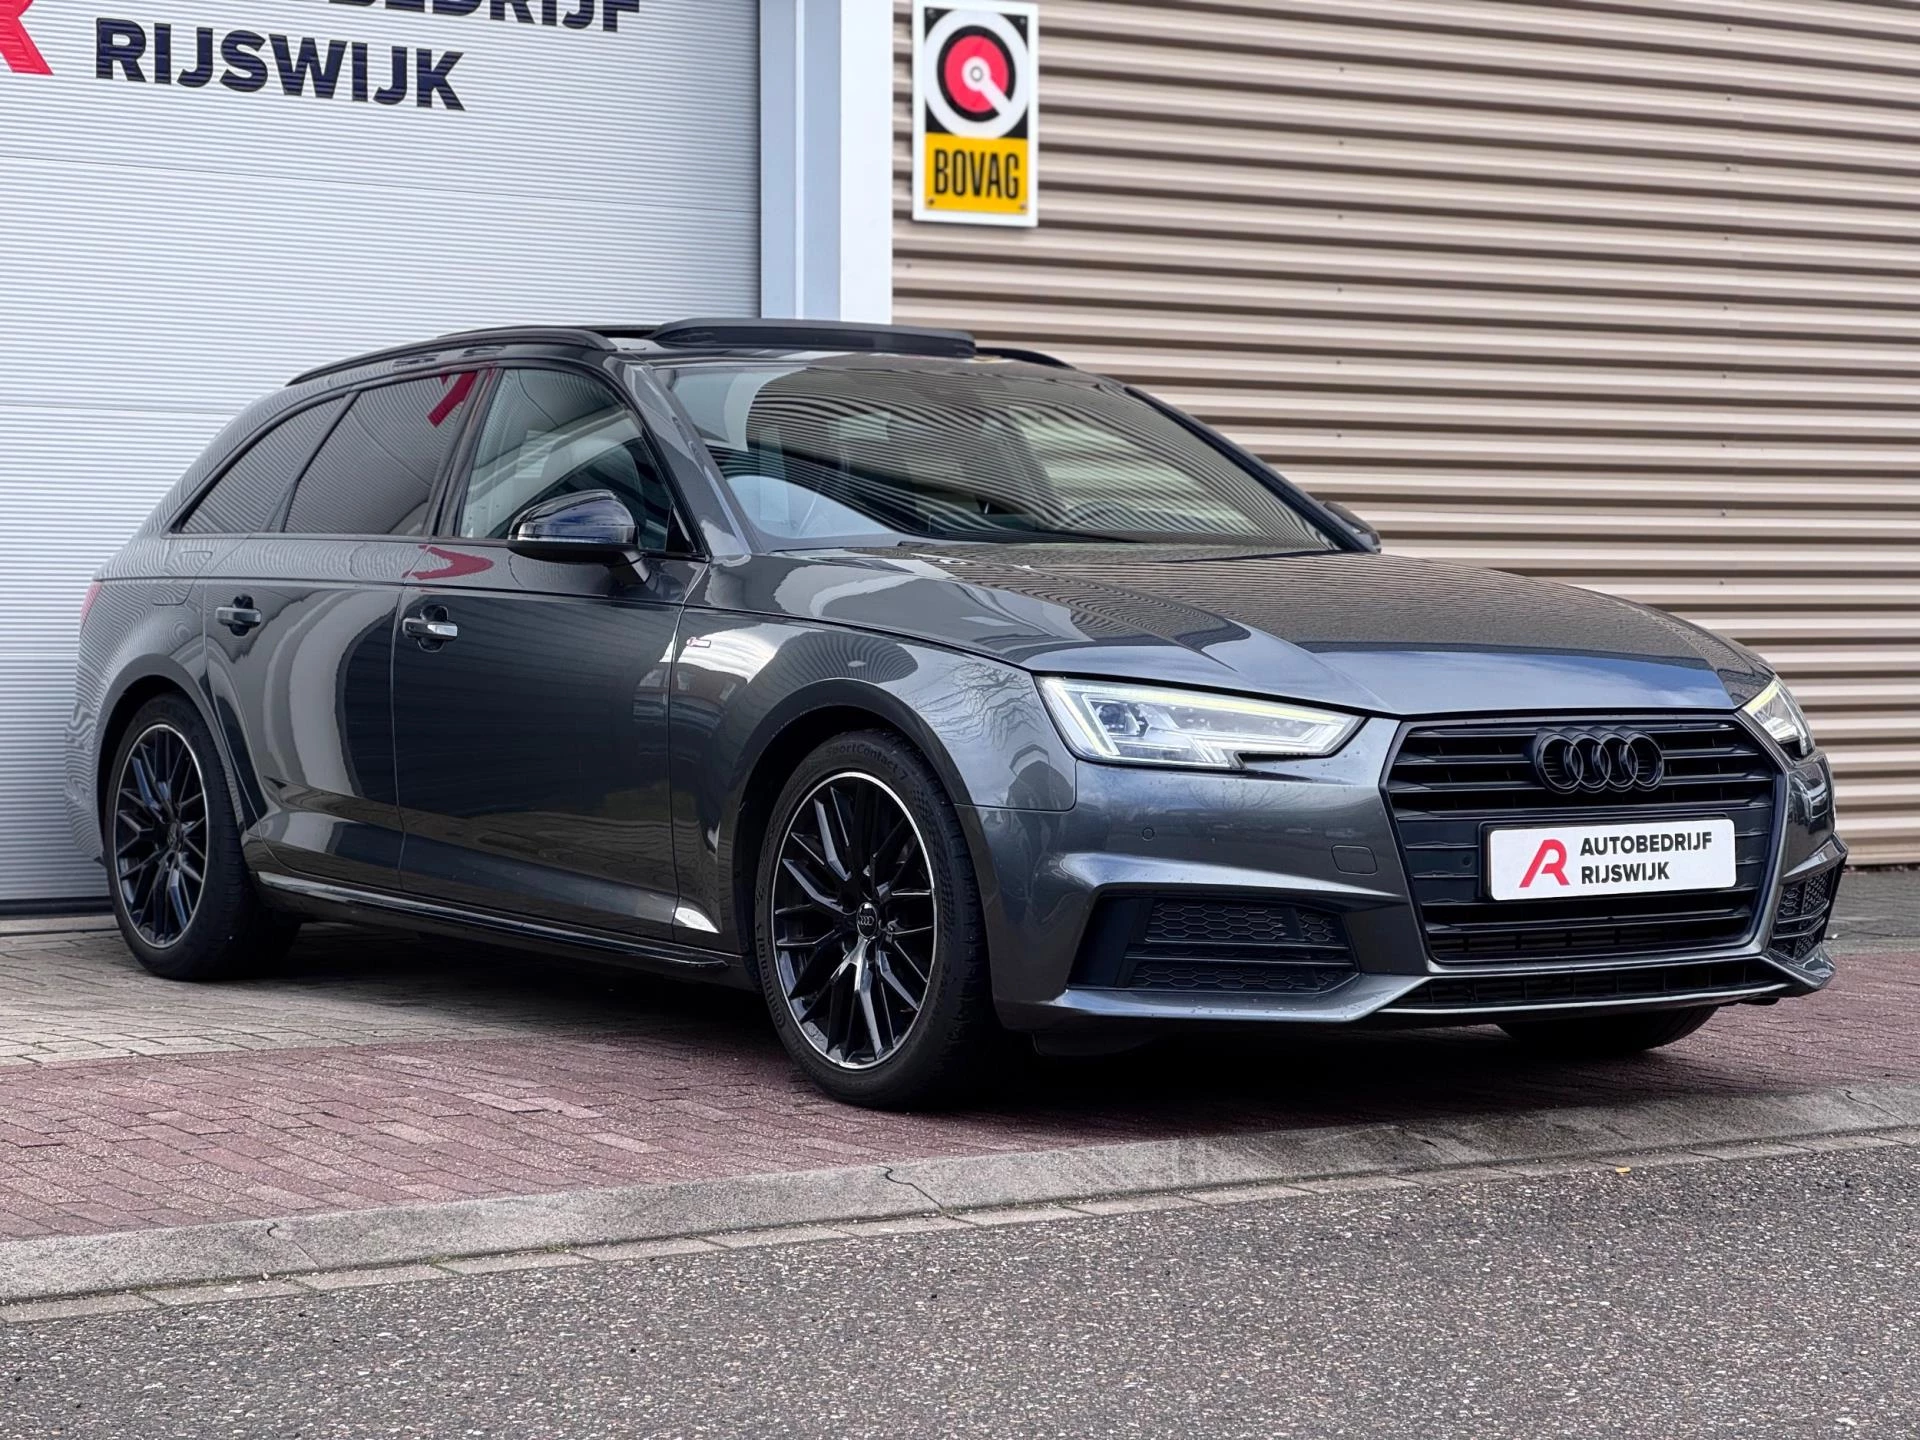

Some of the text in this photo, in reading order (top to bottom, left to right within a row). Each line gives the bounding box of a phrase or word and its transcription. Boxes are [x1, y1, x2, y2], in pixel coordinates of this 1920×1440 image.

[96, 17, 466, 111] RIJSWIJK
[934, 149, 1019, 199] BOVAG
[1580, 832, 1712, 856] AUTOBEDRIJF
[1580, 861, 1670, 885] RIJSWIJK
